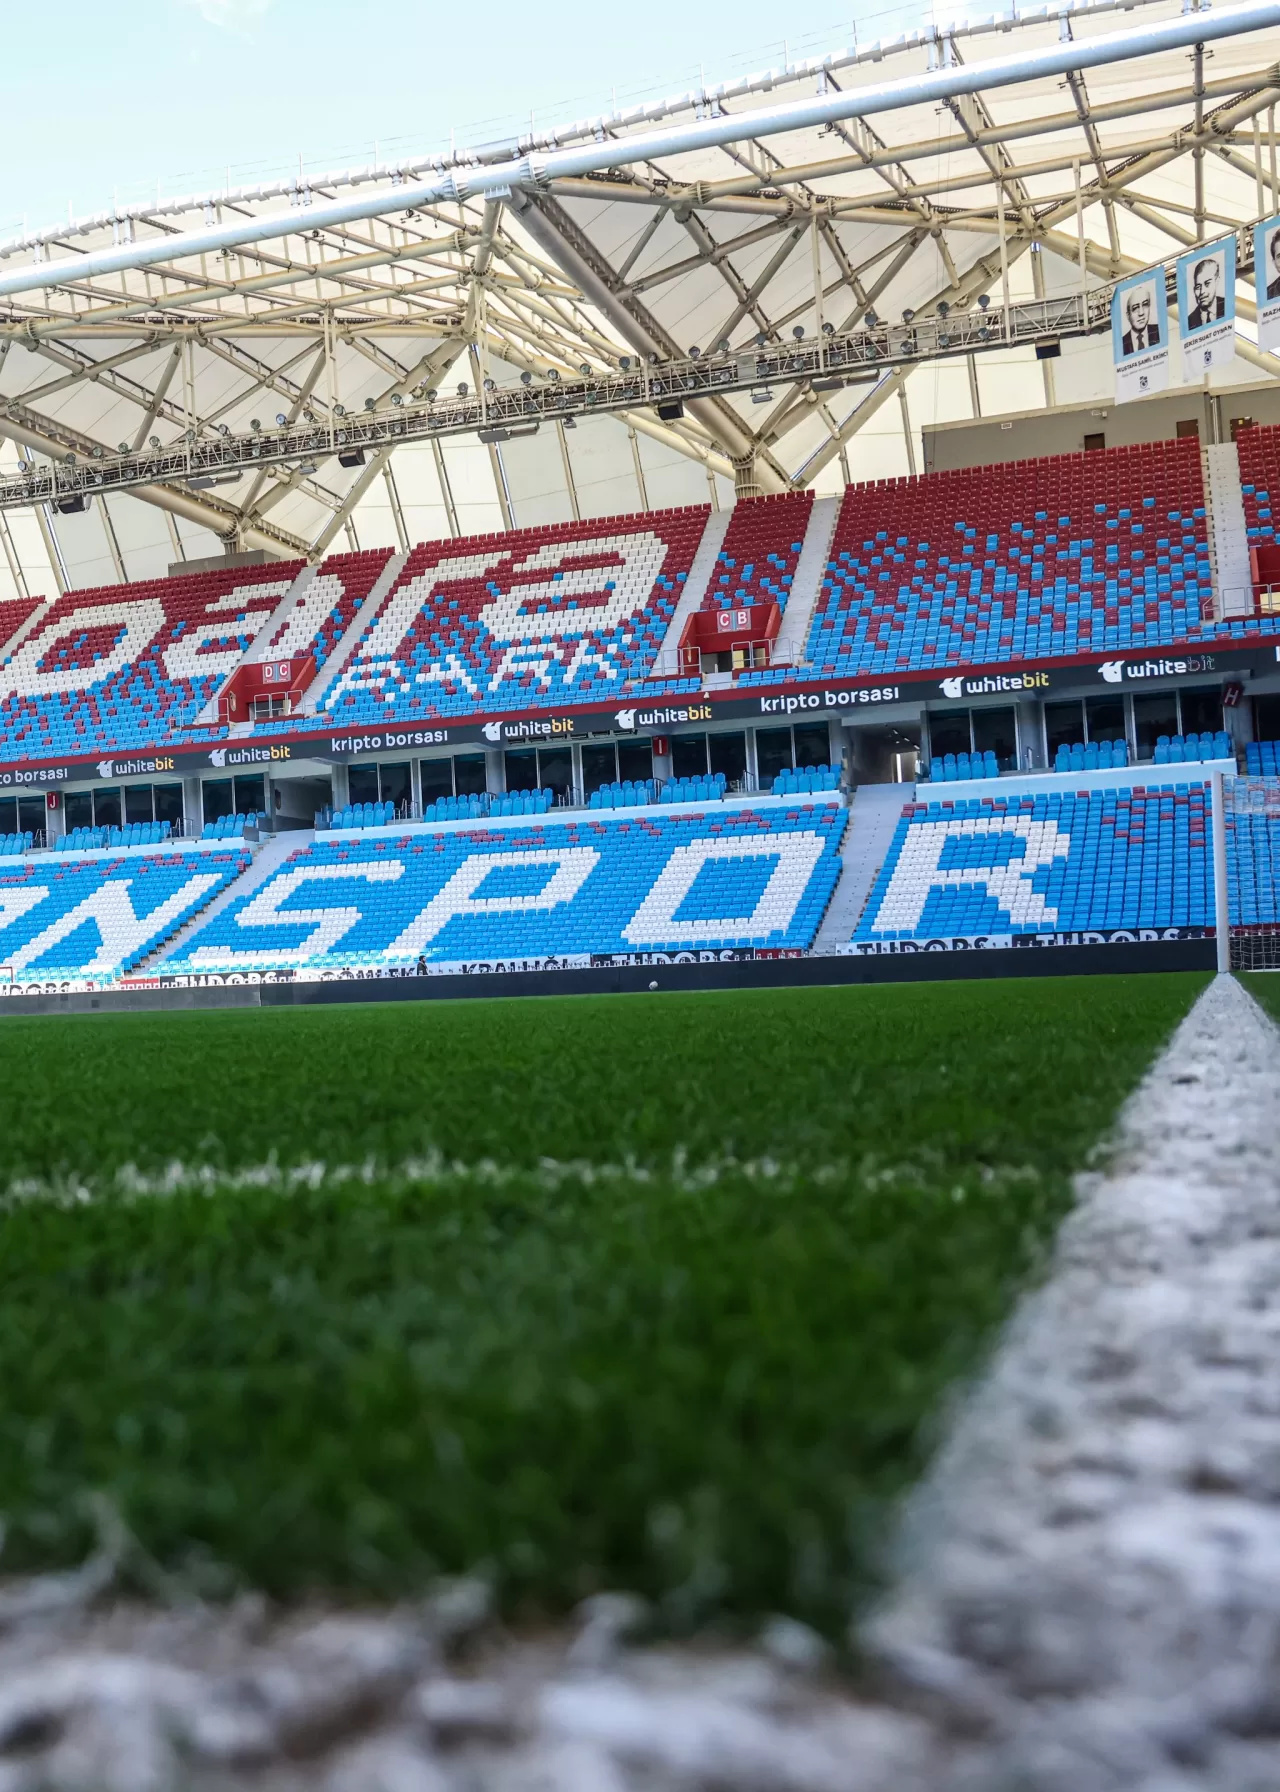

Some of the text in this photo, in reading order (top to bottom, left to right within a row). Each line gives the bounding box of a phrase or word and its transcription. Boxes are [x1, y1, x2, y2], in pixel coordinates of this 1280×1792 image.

[1199, 332, 1212, 343] SUAT
[1116, 362, 1138, 373] MUSTAFA
[720, 611, 747, 626] C B
[264, 663, 287, 677] D C
[324, 633, 633, 711] PARK
[1127, 655, 1215, 678] whitebit
[967, 672, 1049, 694] whitebit
[761, 687, 899, 714] kripto borsası
[1223, 687, 1239, 706] H
[638, 705, 712, 725] whitebit
[504, 717, 574, 736] whitebit
[331, 729, 448, 753] kripto borsası
[229, 745, 291, 763] whitebit
[115, 757, 174, 775] whitebit
[15, 768, 68, 783] borsası
[49, 793, 56, 809] J
[857, 937, 988, 953] TUDORS
[1036, 928, 1180, 945] TUDORS
[612, 950, 734, 966] TUDORS
[175, 972, 277, 987] TUDORS
